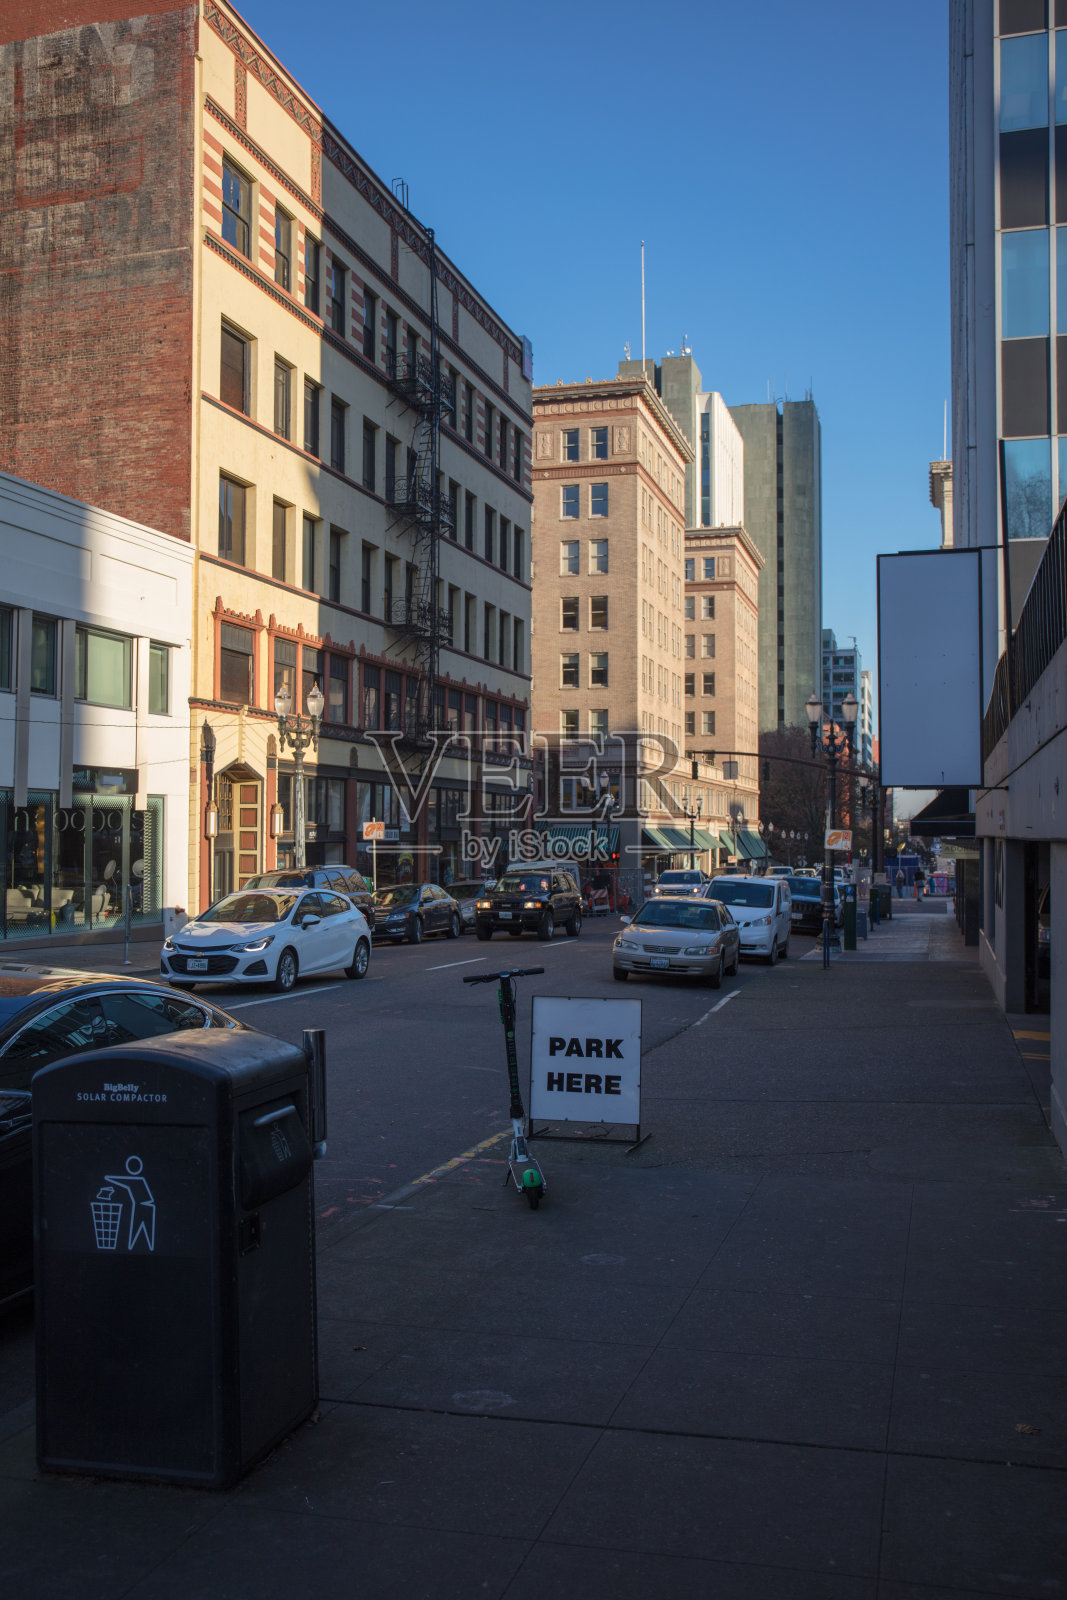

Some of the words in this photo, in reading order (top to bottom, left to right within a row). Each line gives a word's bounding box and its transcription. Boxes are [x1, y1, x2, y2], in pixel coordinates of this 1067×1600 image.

[548, 1036, 625, 1059] PARK
[103, 1083, 139, 1093] BigBelly
[546, 1071, 622, 1096] HERE
[76, 1092, 107, 1101] SOLAR
[109, 1093, 168, 1103] COMPACTOR
